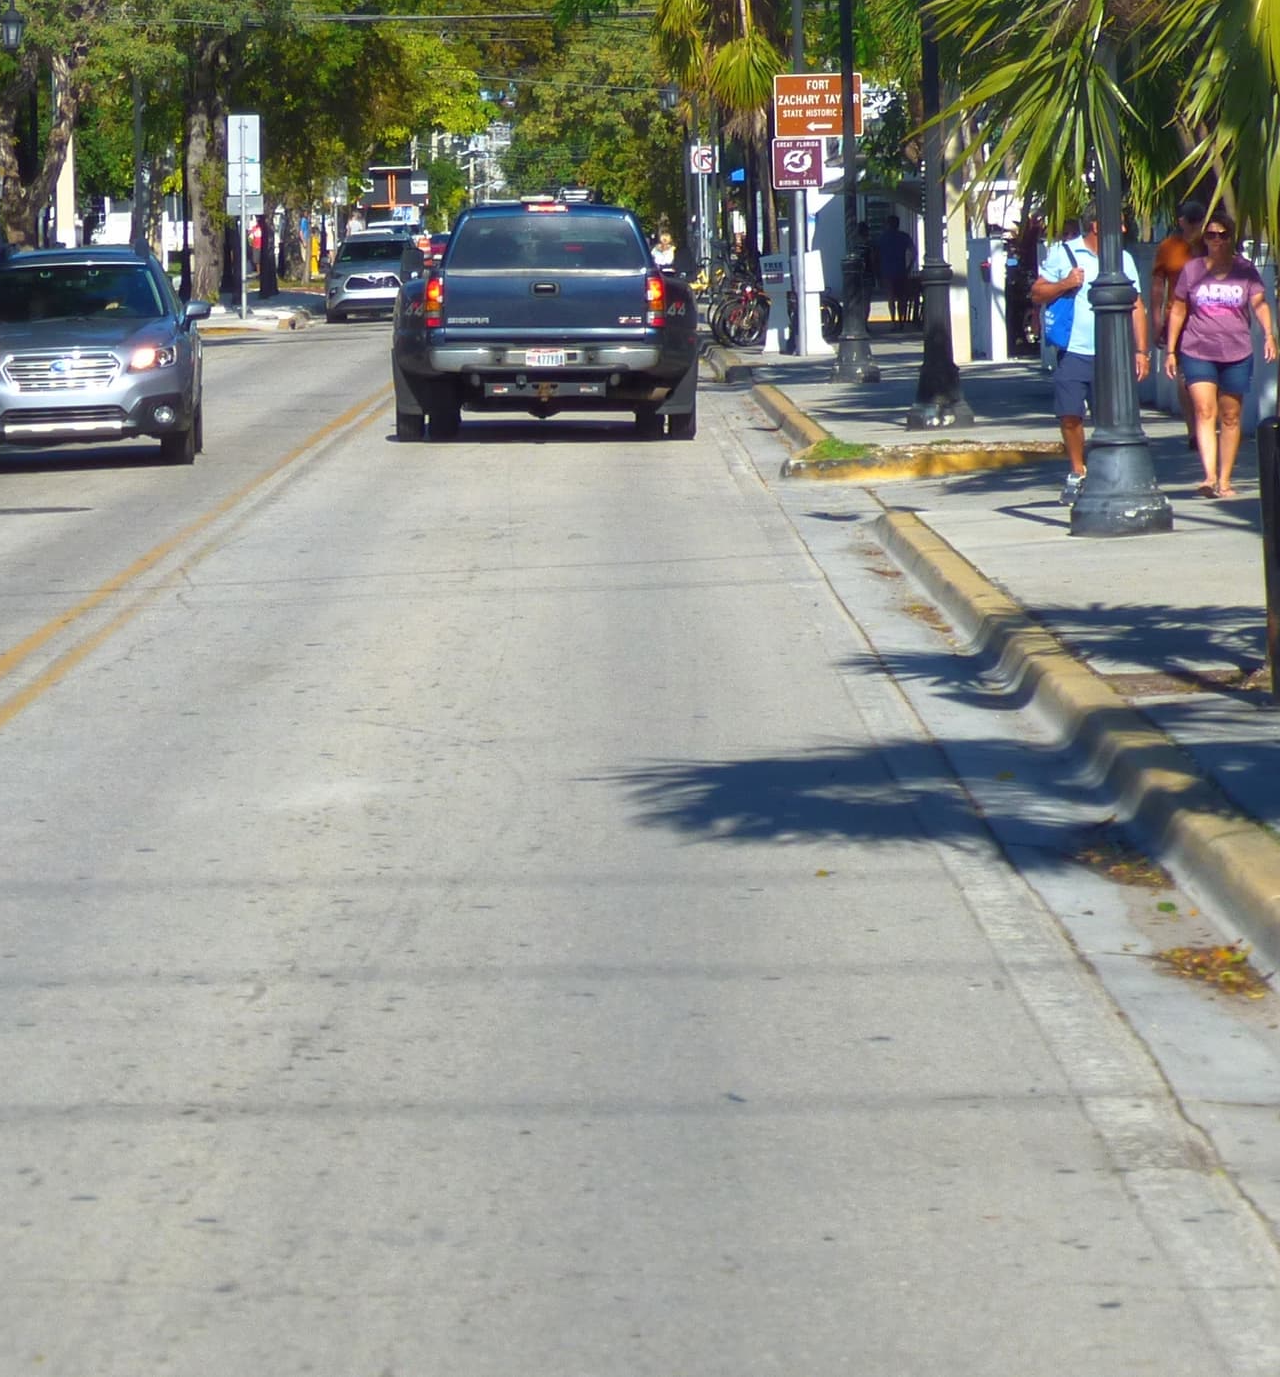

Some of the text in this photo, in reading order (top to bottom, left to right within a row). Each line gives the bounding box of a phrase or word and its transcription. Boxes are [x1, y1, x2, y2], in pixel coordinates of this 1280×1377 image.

[806, 80, 830, 90] FORT
[778, 94, 860, 105] ZACHARY TAYR
[782, 109, 803, 118] STATE
[806, 108, 838, 117] HISTORIC
[1196, 284, 1243, 298] AERO
